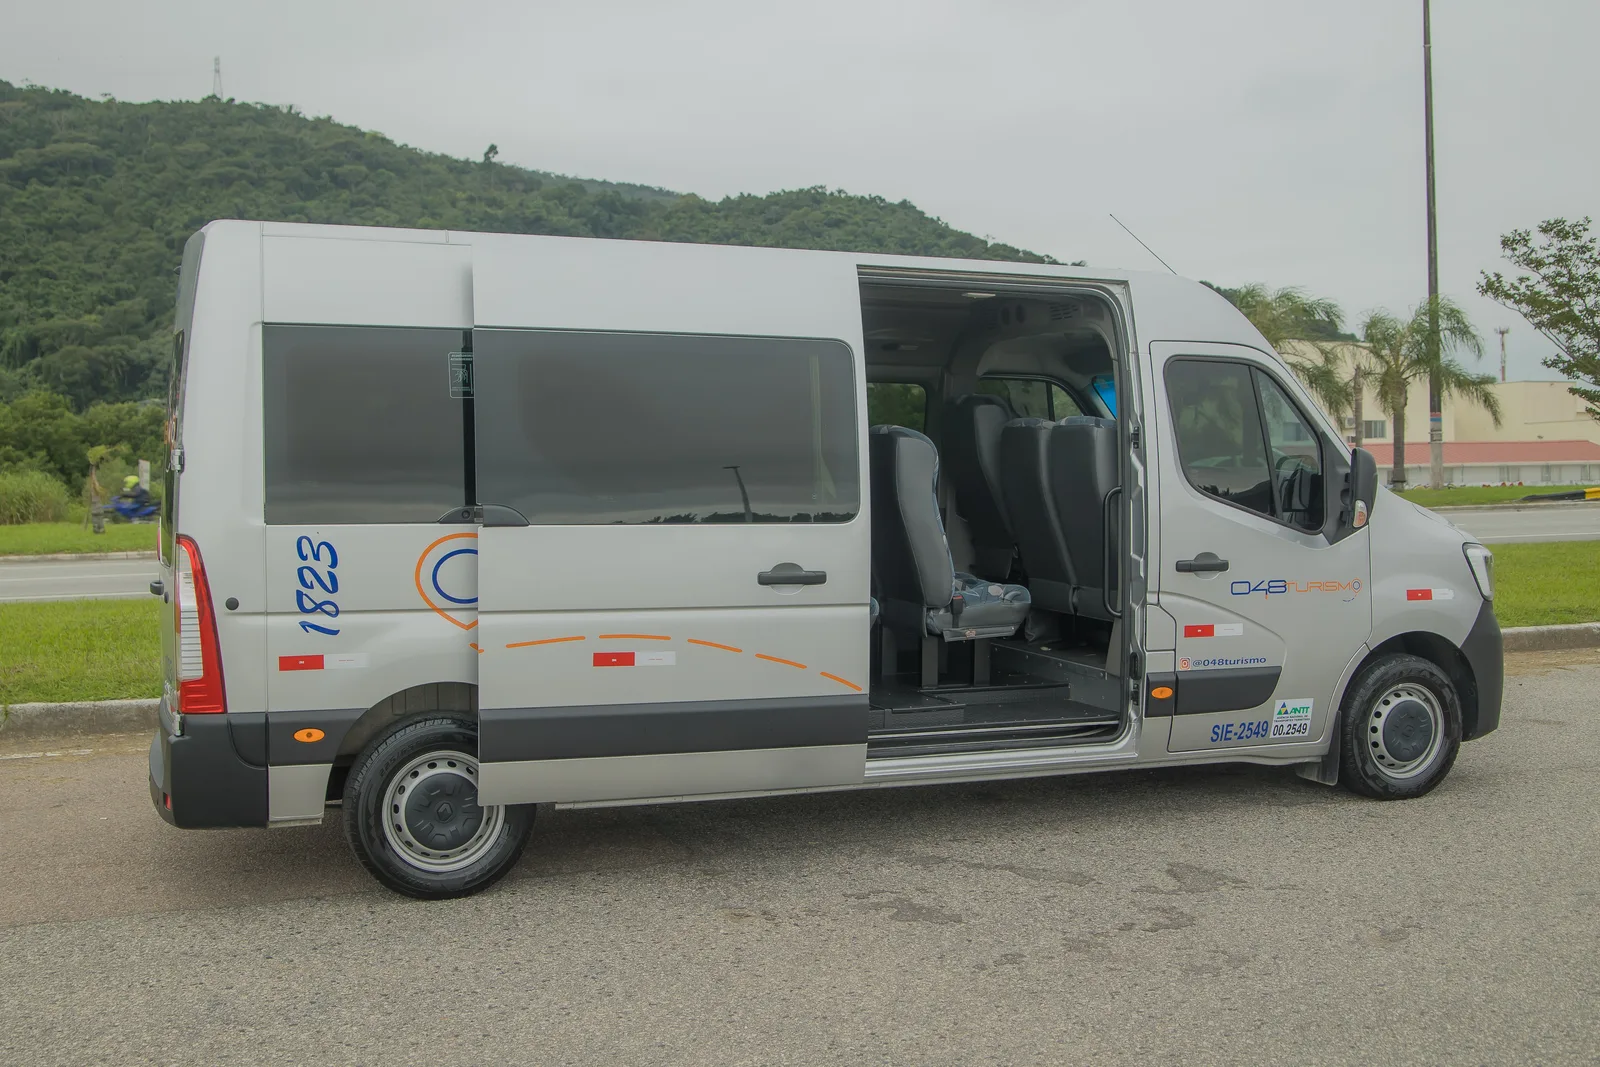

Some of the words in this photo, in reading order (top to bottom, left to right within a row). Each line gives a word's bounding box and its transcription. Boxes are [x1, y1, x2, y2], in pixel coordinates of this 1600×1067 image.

[296, 535, 340, 635] 1823
[1192, 657, 1267, 667] @048turismo
[1289, 706, 1310, 714] ANTT
[1210, 720, 1269, 742] SIE-2549
[1272, 722, 1308, 736] 00.2549
